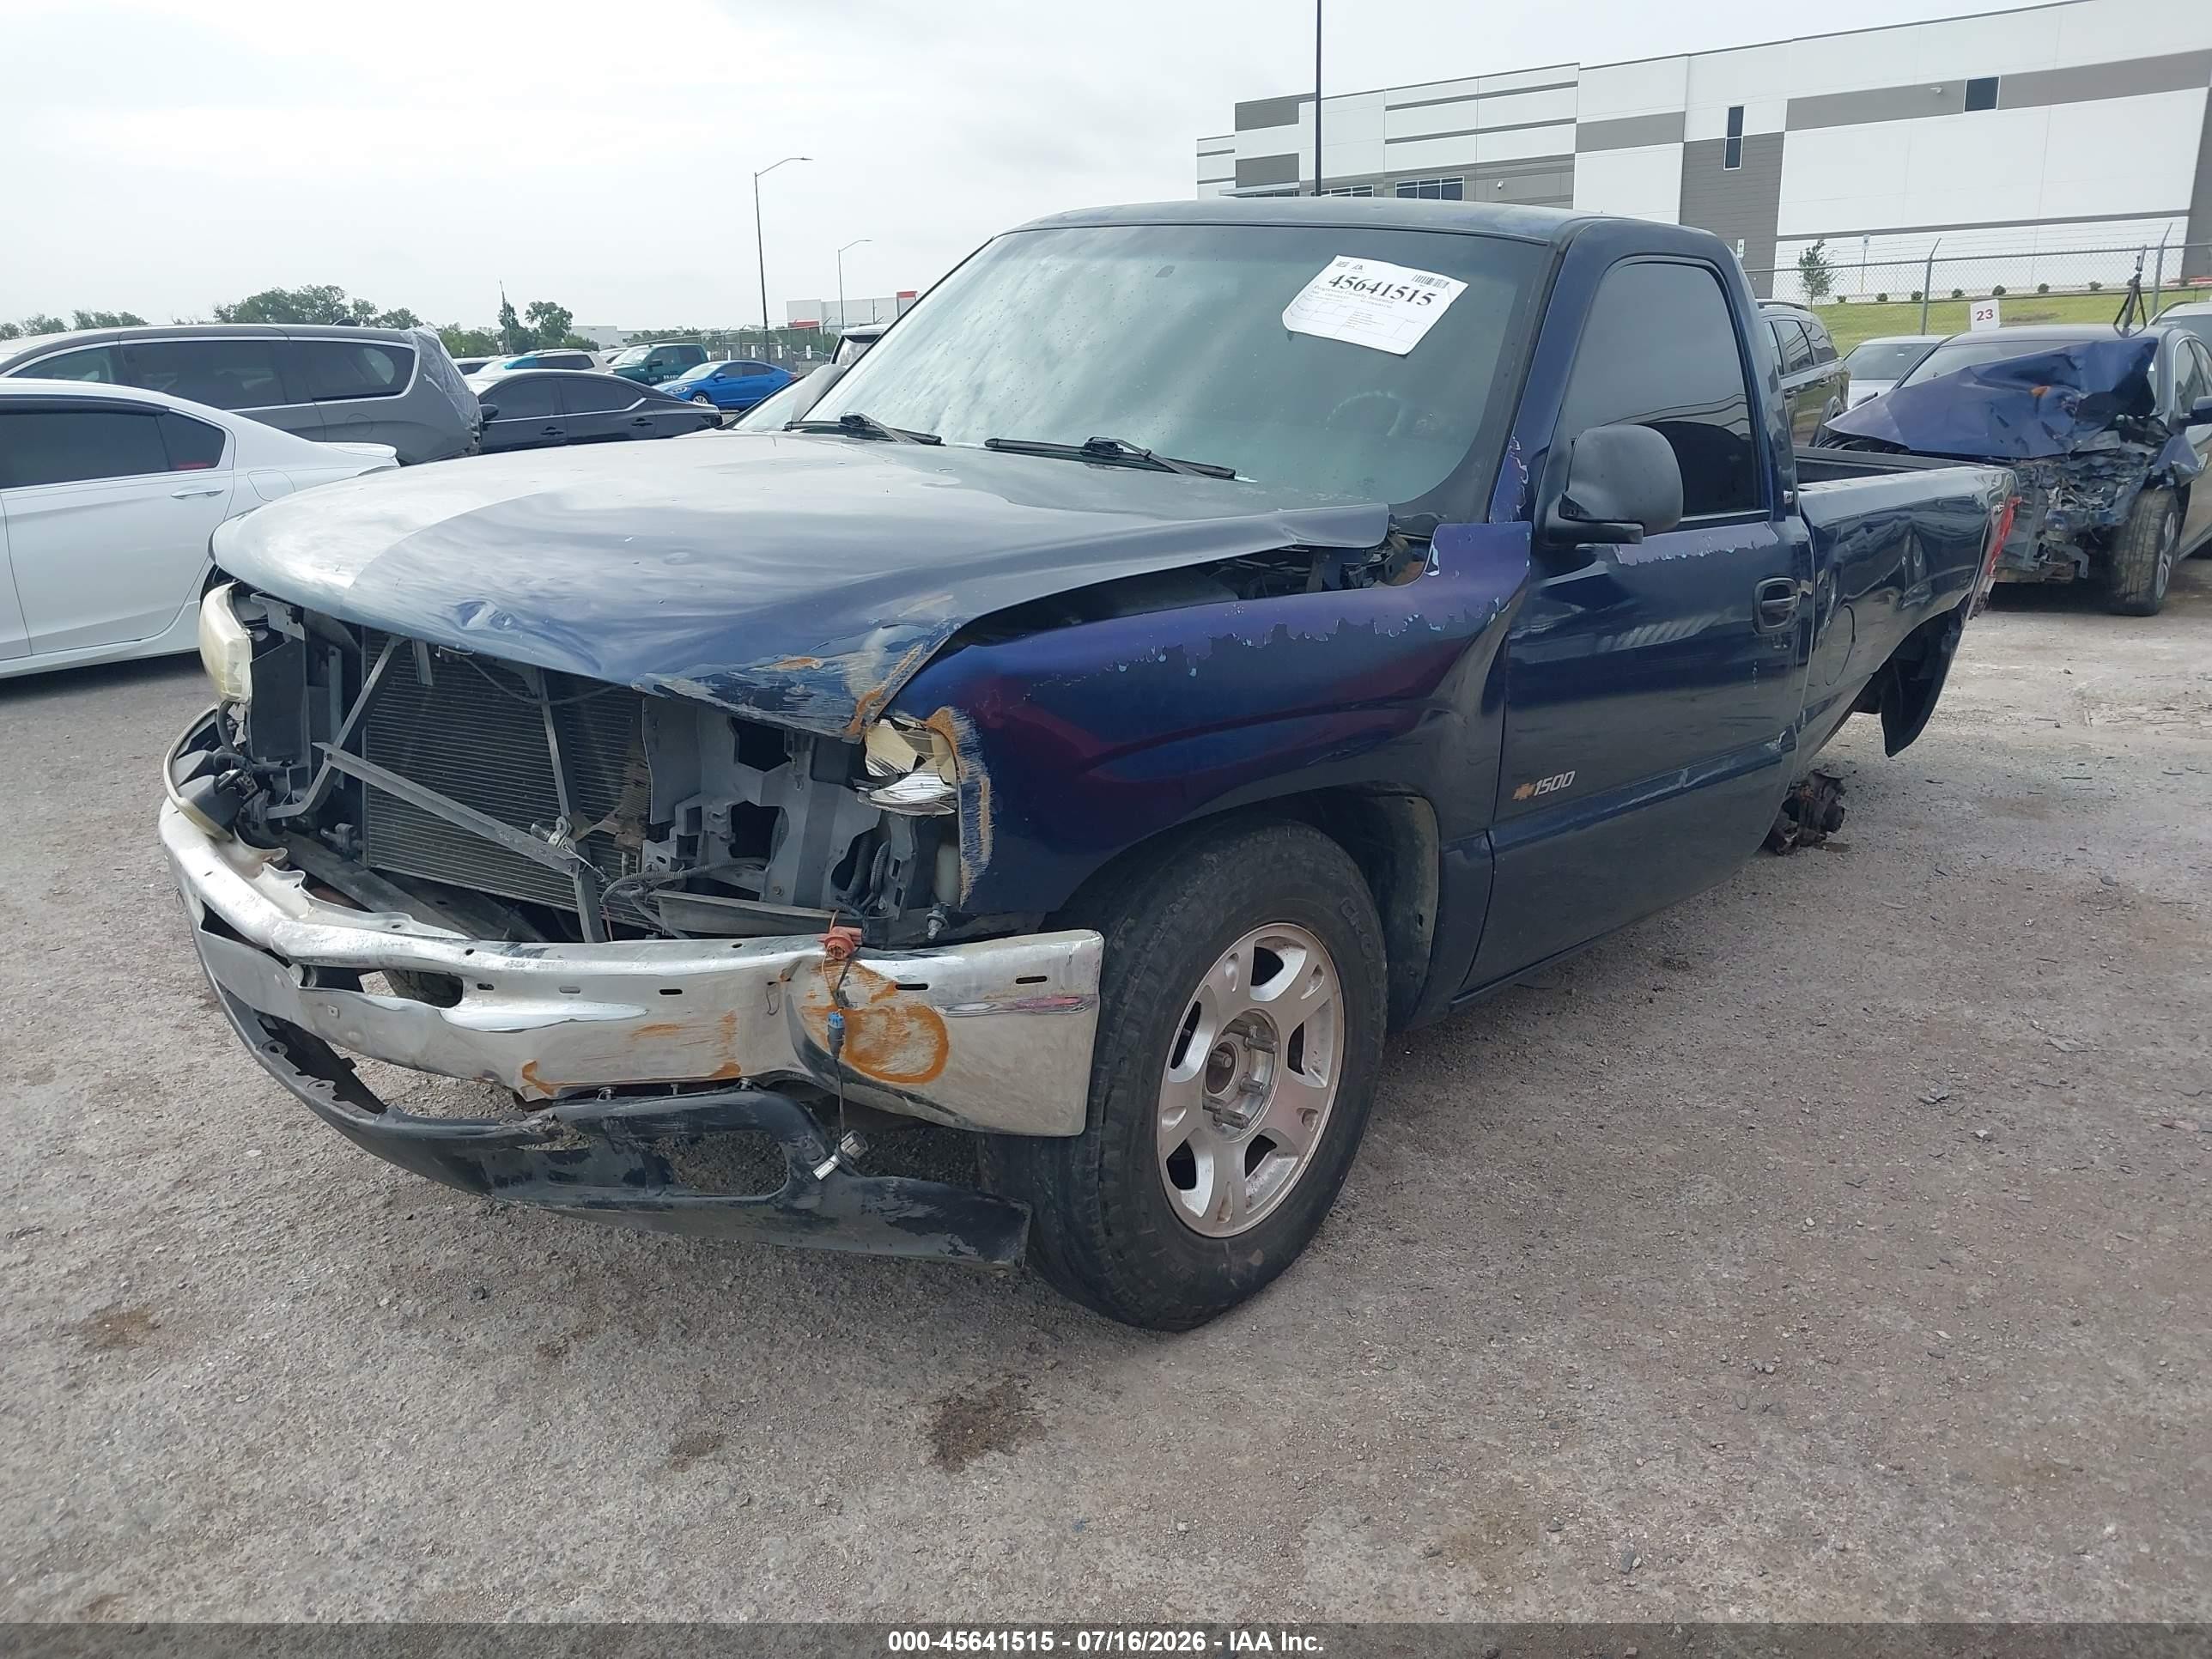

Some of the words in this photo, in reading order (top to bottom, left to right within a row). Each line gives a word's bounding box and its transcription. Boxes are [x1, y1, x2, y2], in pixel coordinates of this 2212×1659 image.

[1328, 274, 1437, 307] 45641515
[1977, 308, 1993, 321] 23
[1534, 770, 1576, 796] 1500
